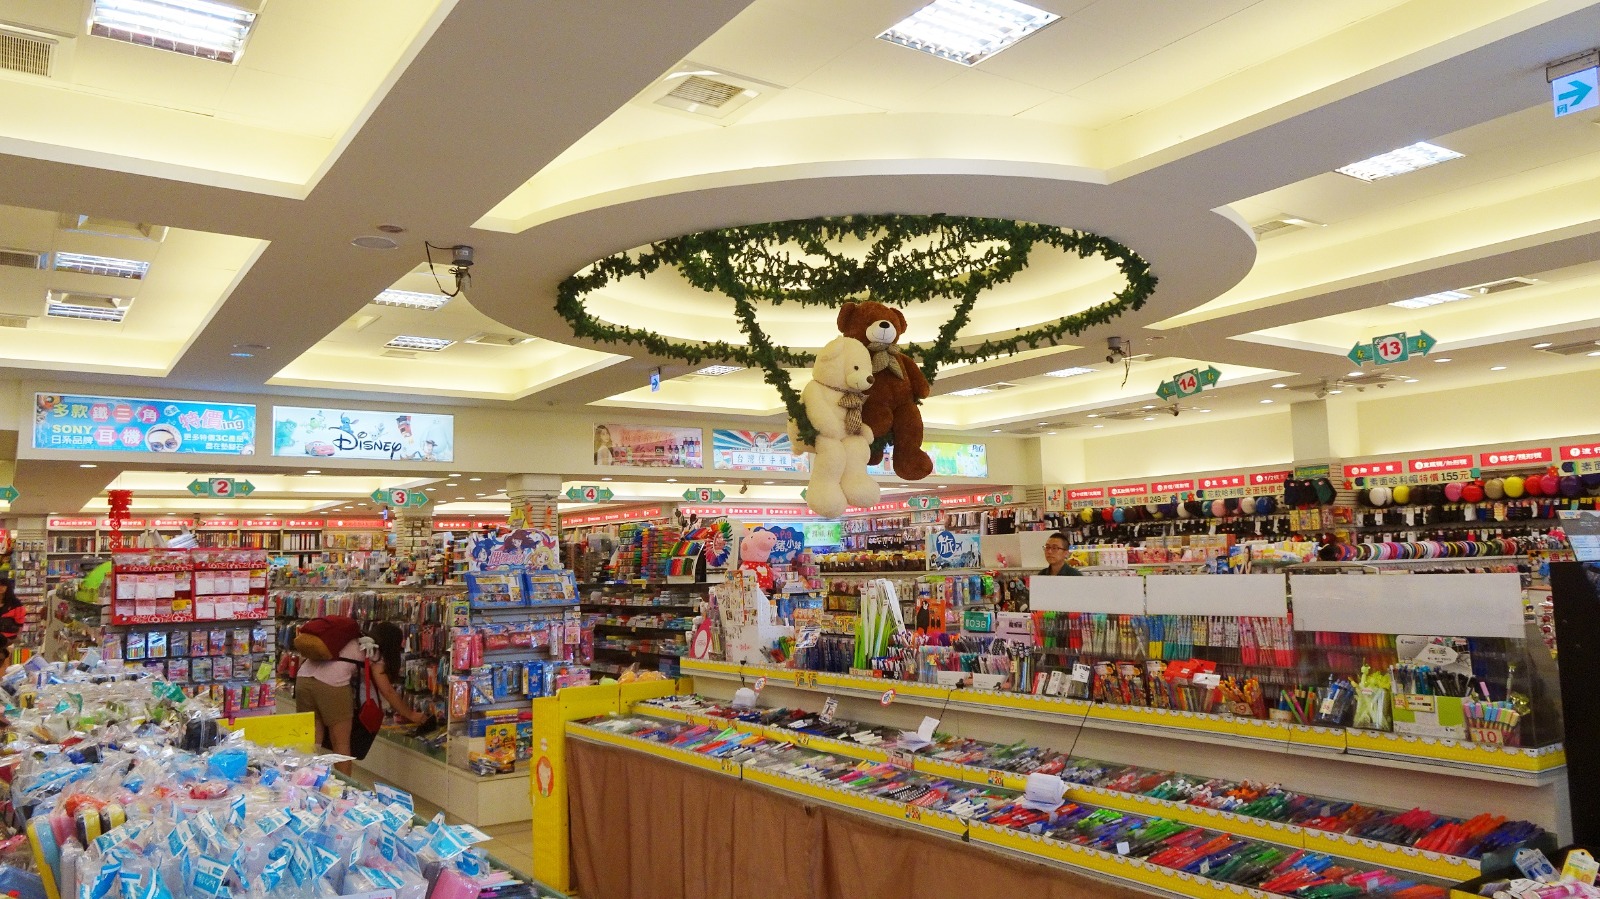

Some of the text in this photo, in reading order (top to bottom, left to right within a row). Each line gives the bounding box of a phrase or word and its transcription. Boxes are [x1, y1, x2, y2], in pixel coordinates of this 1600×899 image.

[1380, 341, 1401, 357] 13
[1179, 375, 1196, 391] 14
[52, 424, 93, 435] SONY
[51, 435, 93, 445] 日系品牌
[98, 428, 141, 445] 耳機
[217, 481, 228, 494] 2
[395, 491, 405, 504] 3
[586, 488, 595, 500] 4
[701, 490, 709, 501] 5
[995, 494, 1002, 504] 8
[921, 498, 928, 508] 7
[779, 529, 792, 539] Pig
[770, 538, 802, 552] 豬小妹
[1478, 730, 1498, 743] 10
